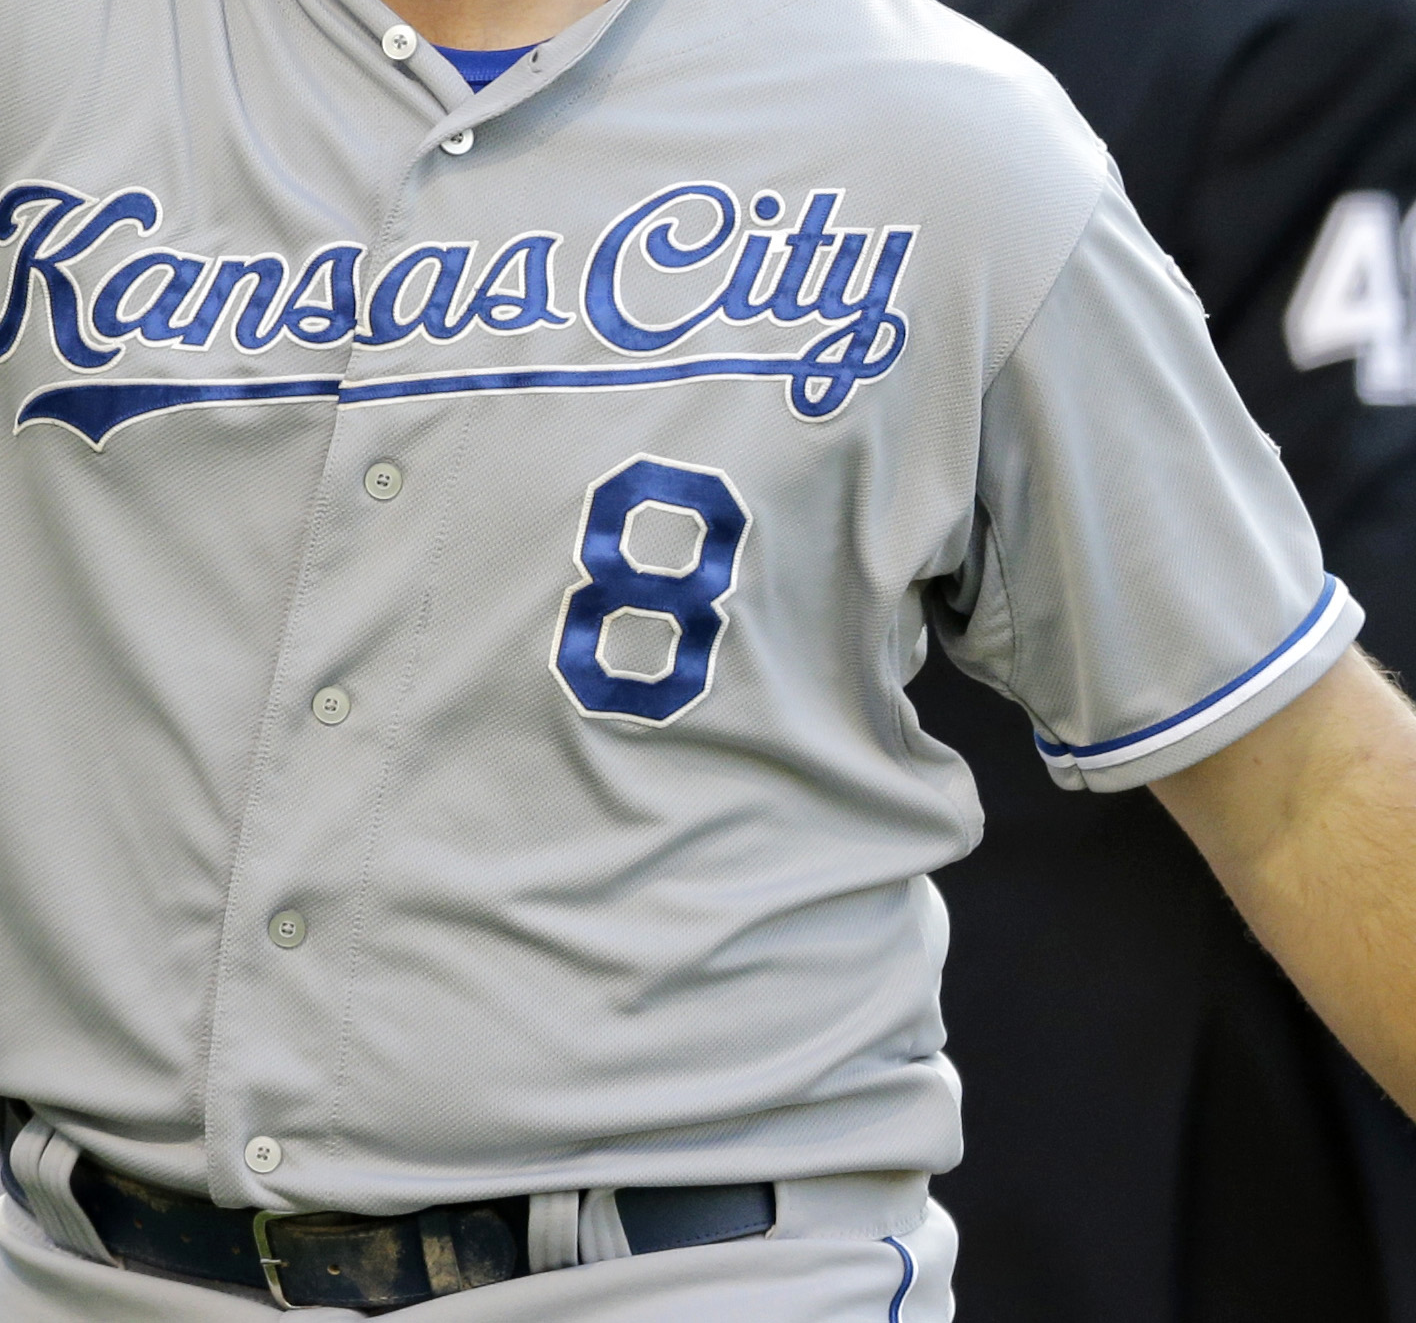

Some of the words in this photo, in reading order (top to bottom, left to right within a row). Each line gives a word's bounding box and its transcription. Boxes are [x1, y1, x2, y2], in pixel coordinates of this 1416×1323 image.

[579, 180, 921, 424] City
[1282, 188, 1416, 406] 4
[548, 451, 753, 728] 8
